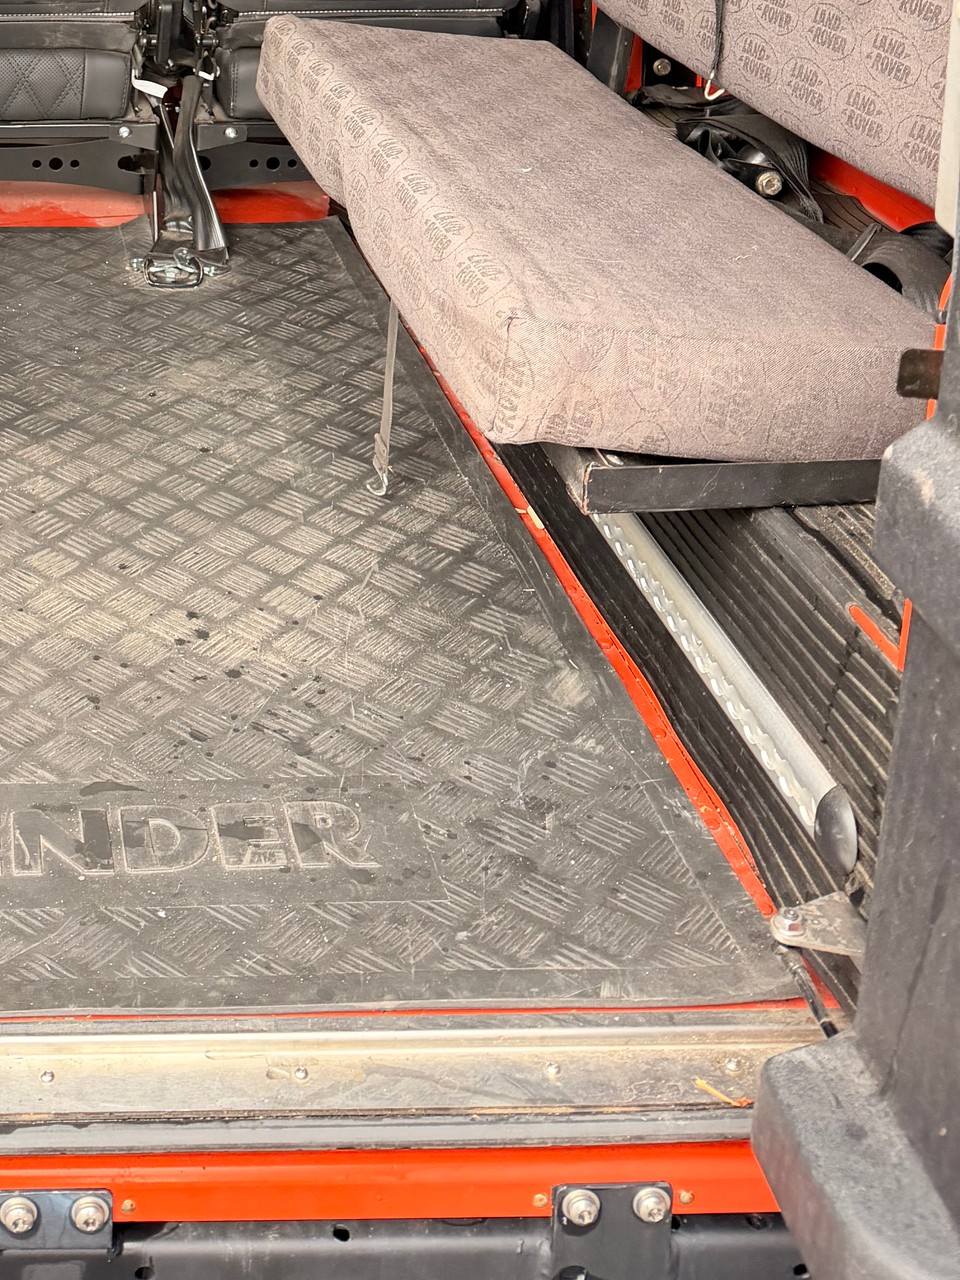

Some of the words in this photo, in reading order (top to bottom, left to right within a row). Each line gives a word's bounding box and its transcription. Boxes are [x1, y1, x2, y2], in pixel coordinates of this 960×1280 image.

[761, 6, 792, 29] ROVER
[813, 8, 841, 31] LAND
[742, 38, 766, 61] LAND
[812, 27, 848, 54] ROVER
[872, 32, 906, 58] LAND
[743, 57, 771, 83] ROVER
[791, 62, 819, 87] LAND
[871, 53, 912, 83] ROVER
[791, 82, 824, 110] ROVER
[846, 89, 877, 116] LAND
[845, 111, 883, 141] ROVER
